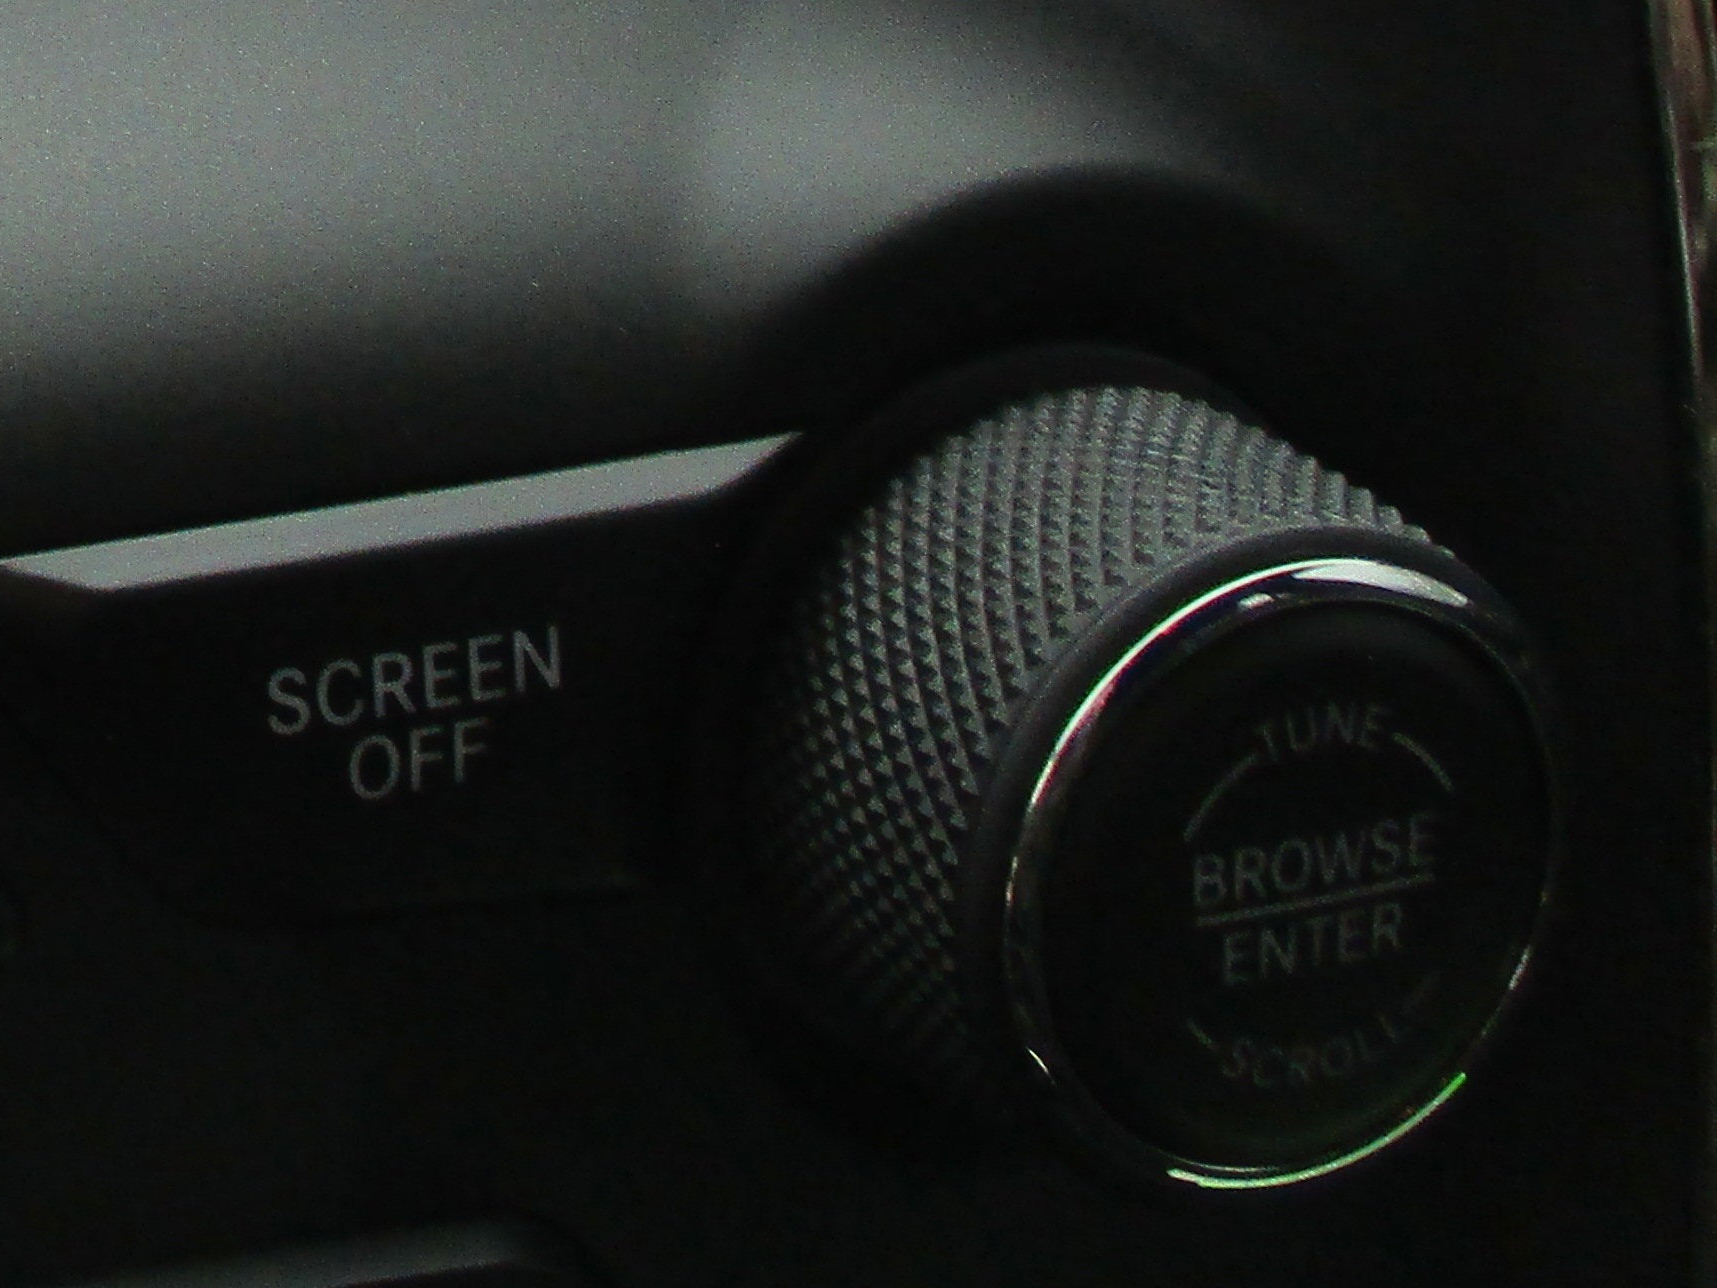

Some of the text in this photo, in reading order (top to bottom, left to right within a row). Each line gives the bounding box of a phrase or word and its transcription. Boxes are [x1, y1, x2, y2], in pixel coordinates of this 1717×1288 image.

[266, 624, 563, 737] SCREEN
[348, 717, 491, 801] OFF
[1255, 700, 1389, 762] TUNE
[1193, 813, 1436, 909] BROWSE
[1221, 902, 1404, 986] ENTER
